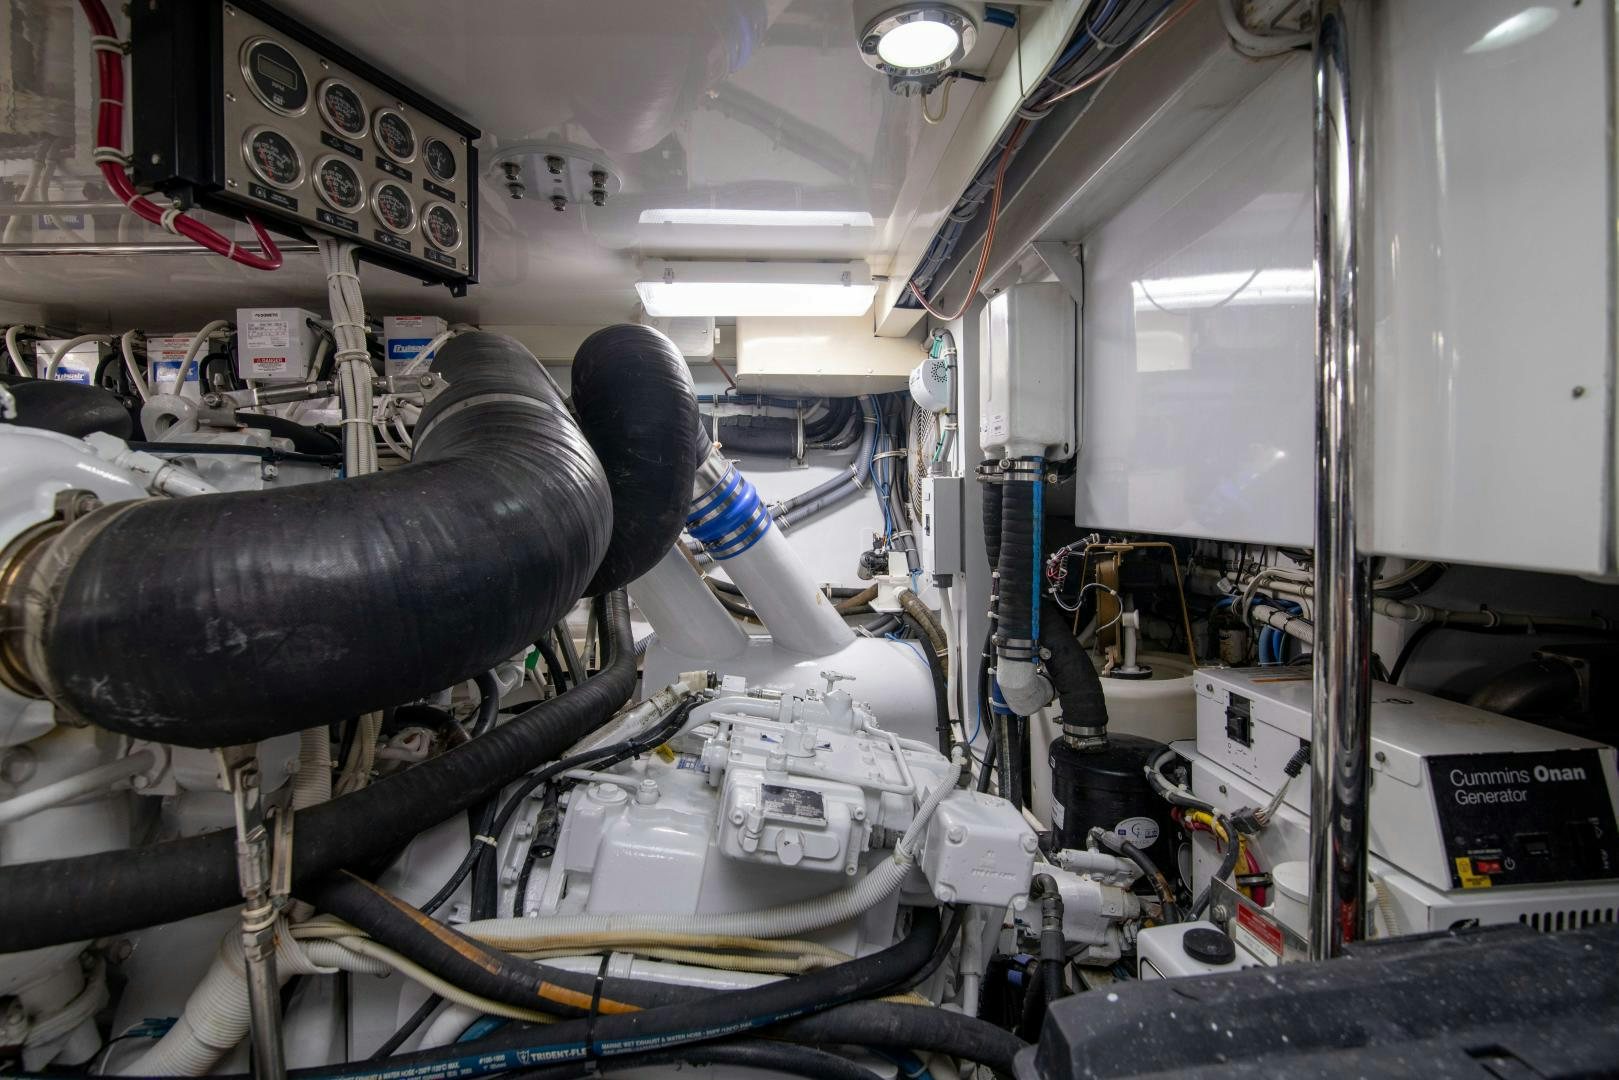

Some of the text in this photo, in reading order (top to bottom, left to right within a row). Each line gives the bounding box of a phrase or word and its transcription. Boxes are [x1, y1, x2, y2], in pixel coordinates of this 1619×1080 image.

[1450, 765, 1586, 787] Cummins Onan
[1455, 789, 1527, 805] Generator
[531, 1047, 588, 1062] TRIDENT-FLE
